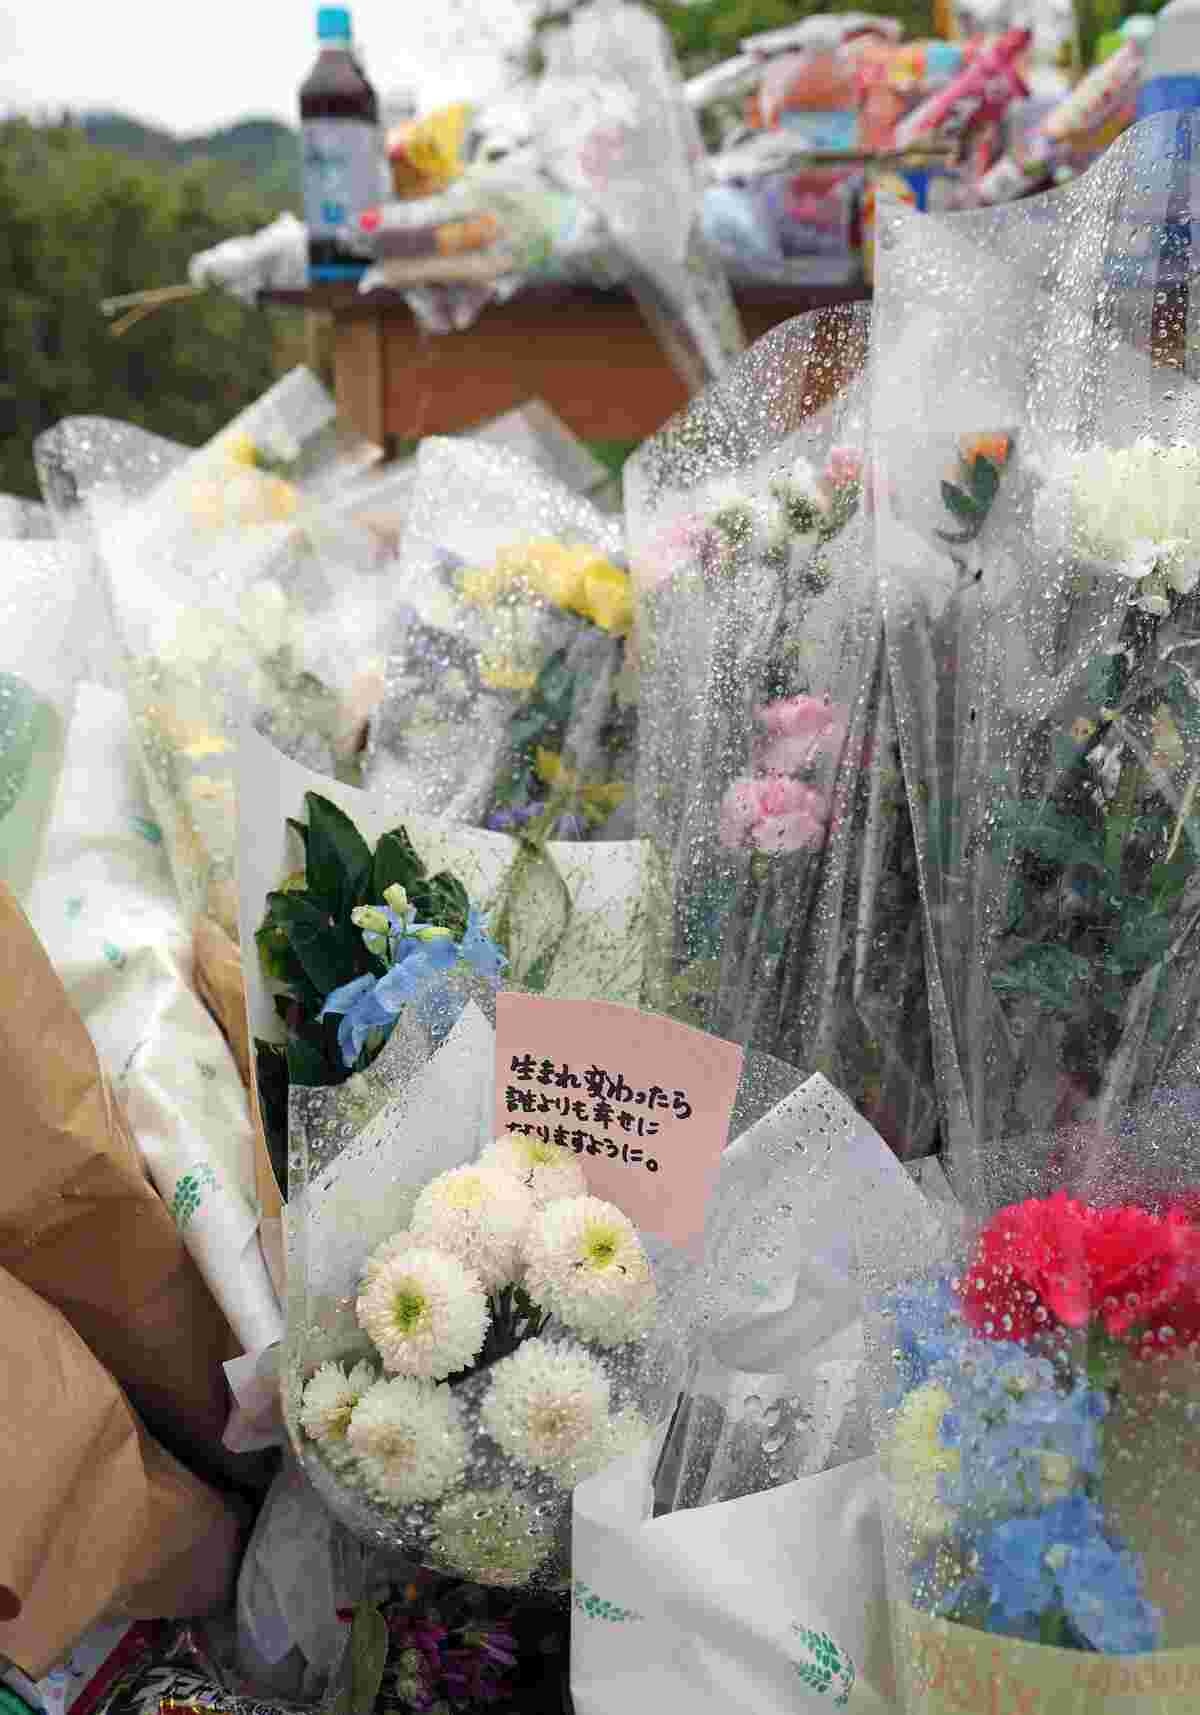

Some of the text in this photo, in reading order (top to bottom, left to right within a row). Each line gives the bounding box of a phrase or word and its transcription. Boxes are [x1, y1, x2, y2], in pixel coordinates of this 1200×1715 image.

[505, 1086, 660, 1136] 誰よりも幸せに
[510, 1054, 693, 1120] 生まれ変わったら
[504, 1121, 659, 1172] なりますように。
